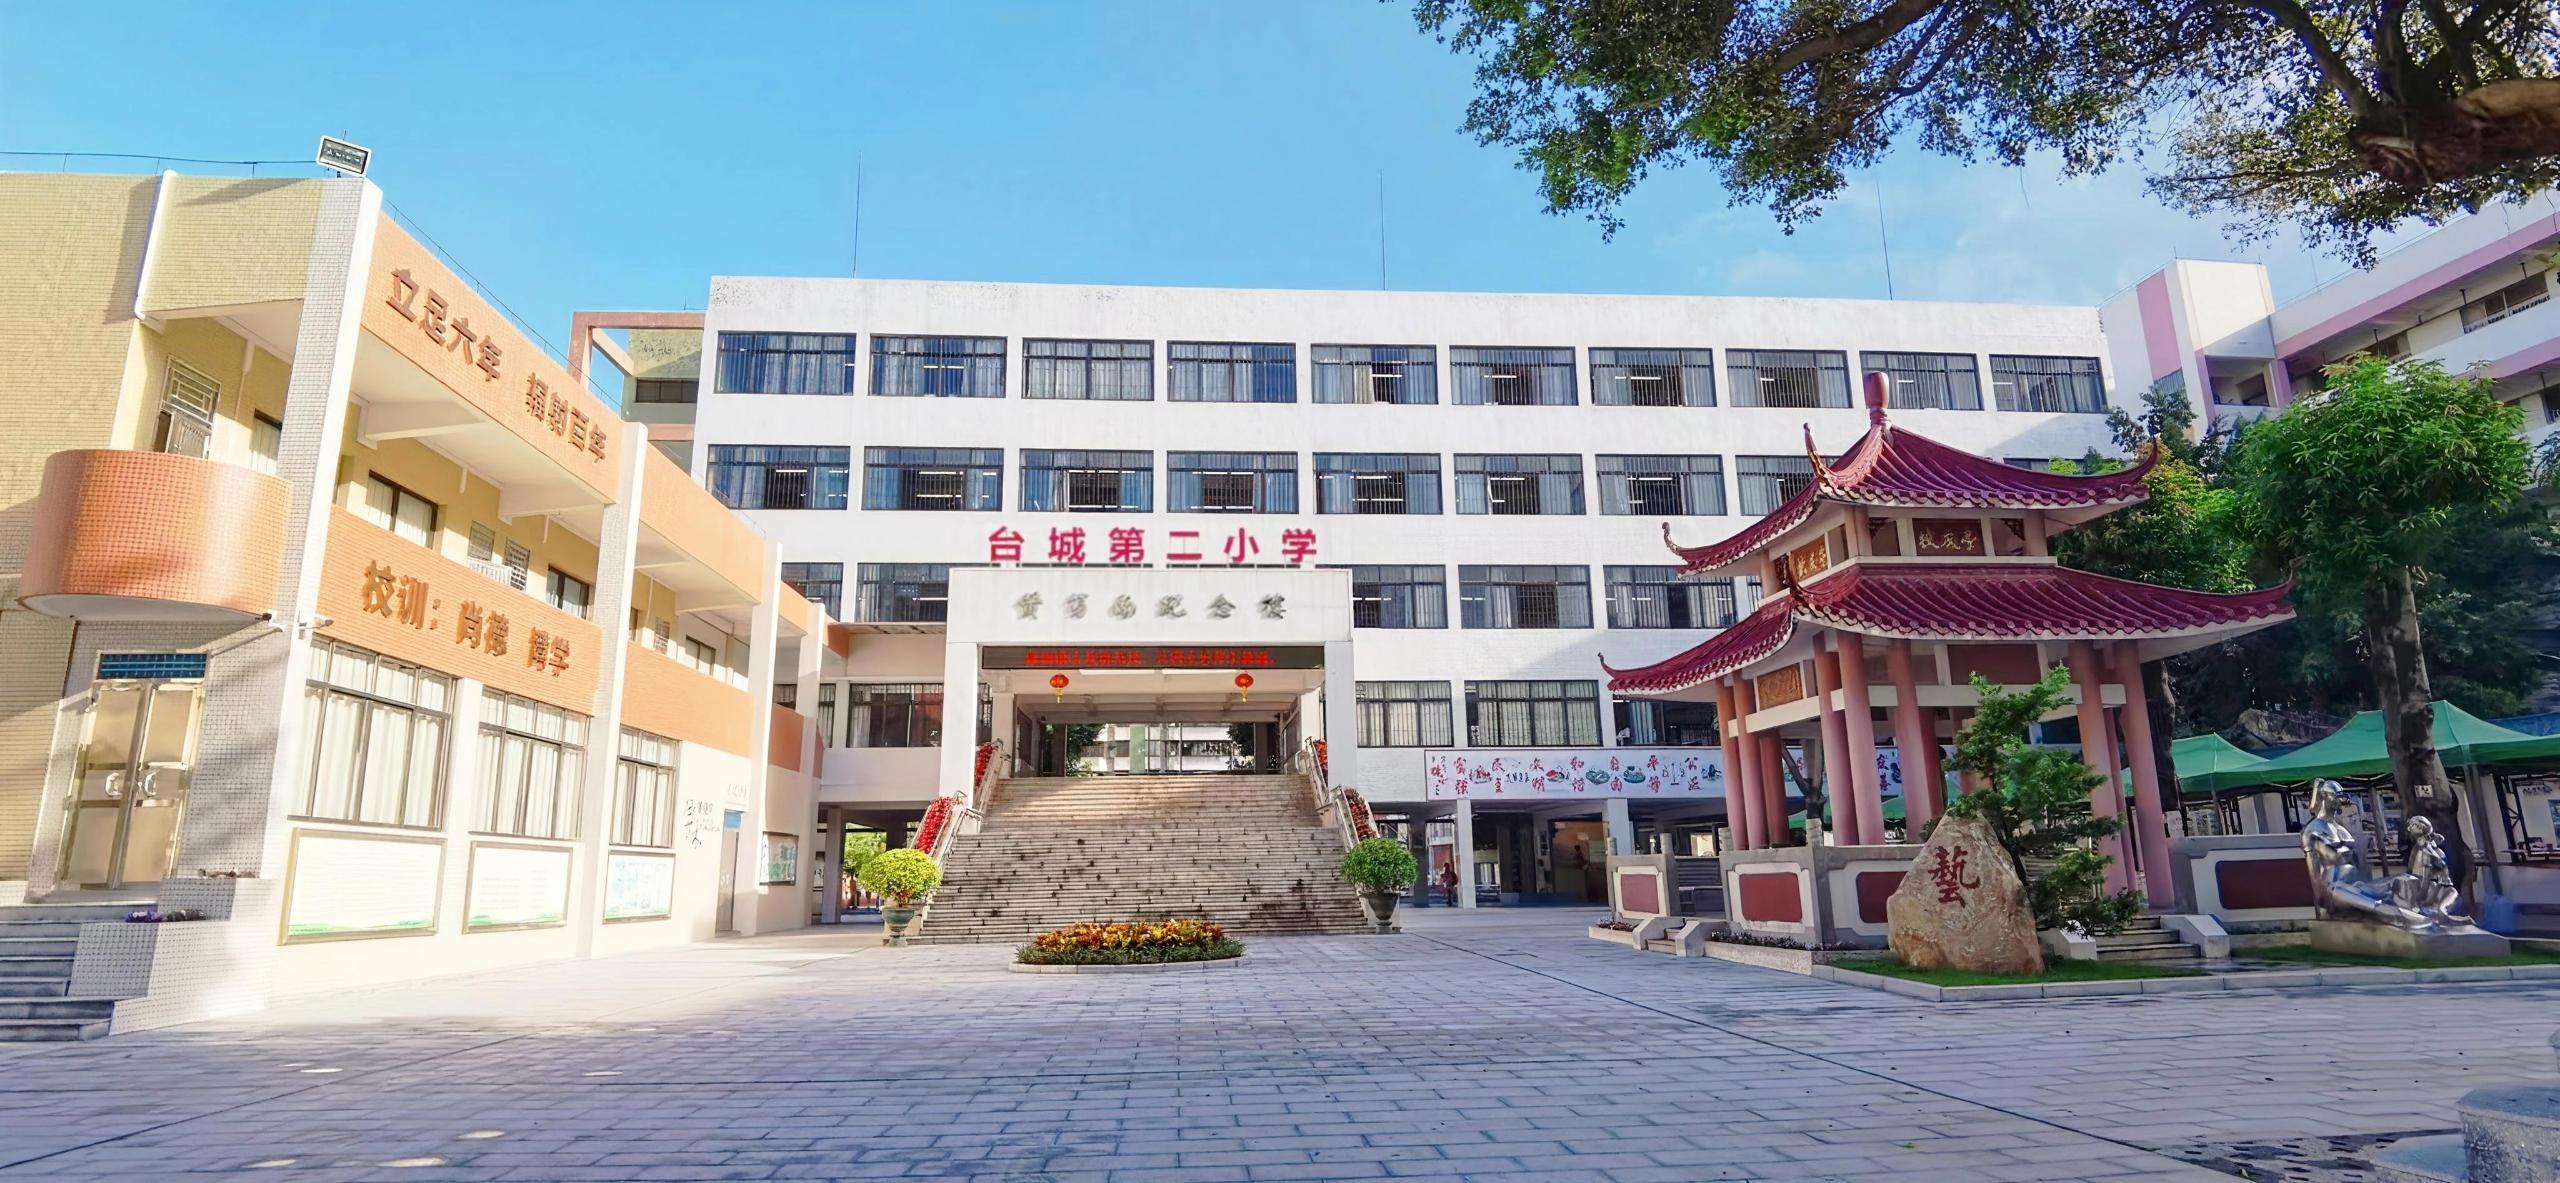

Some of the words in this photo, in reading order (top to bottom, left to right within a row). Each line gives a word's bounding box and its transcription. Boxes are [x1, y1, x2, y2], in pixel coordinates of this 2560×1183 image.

[386, 268, 503, 382] 立足六年
[525, 371, 608, 463] 辐射百年
[988, 526, 1317, 564] 台城第二小学
[456, 600, 510, 657] 尚德
[1927, 845, 1981, 908] 藝
